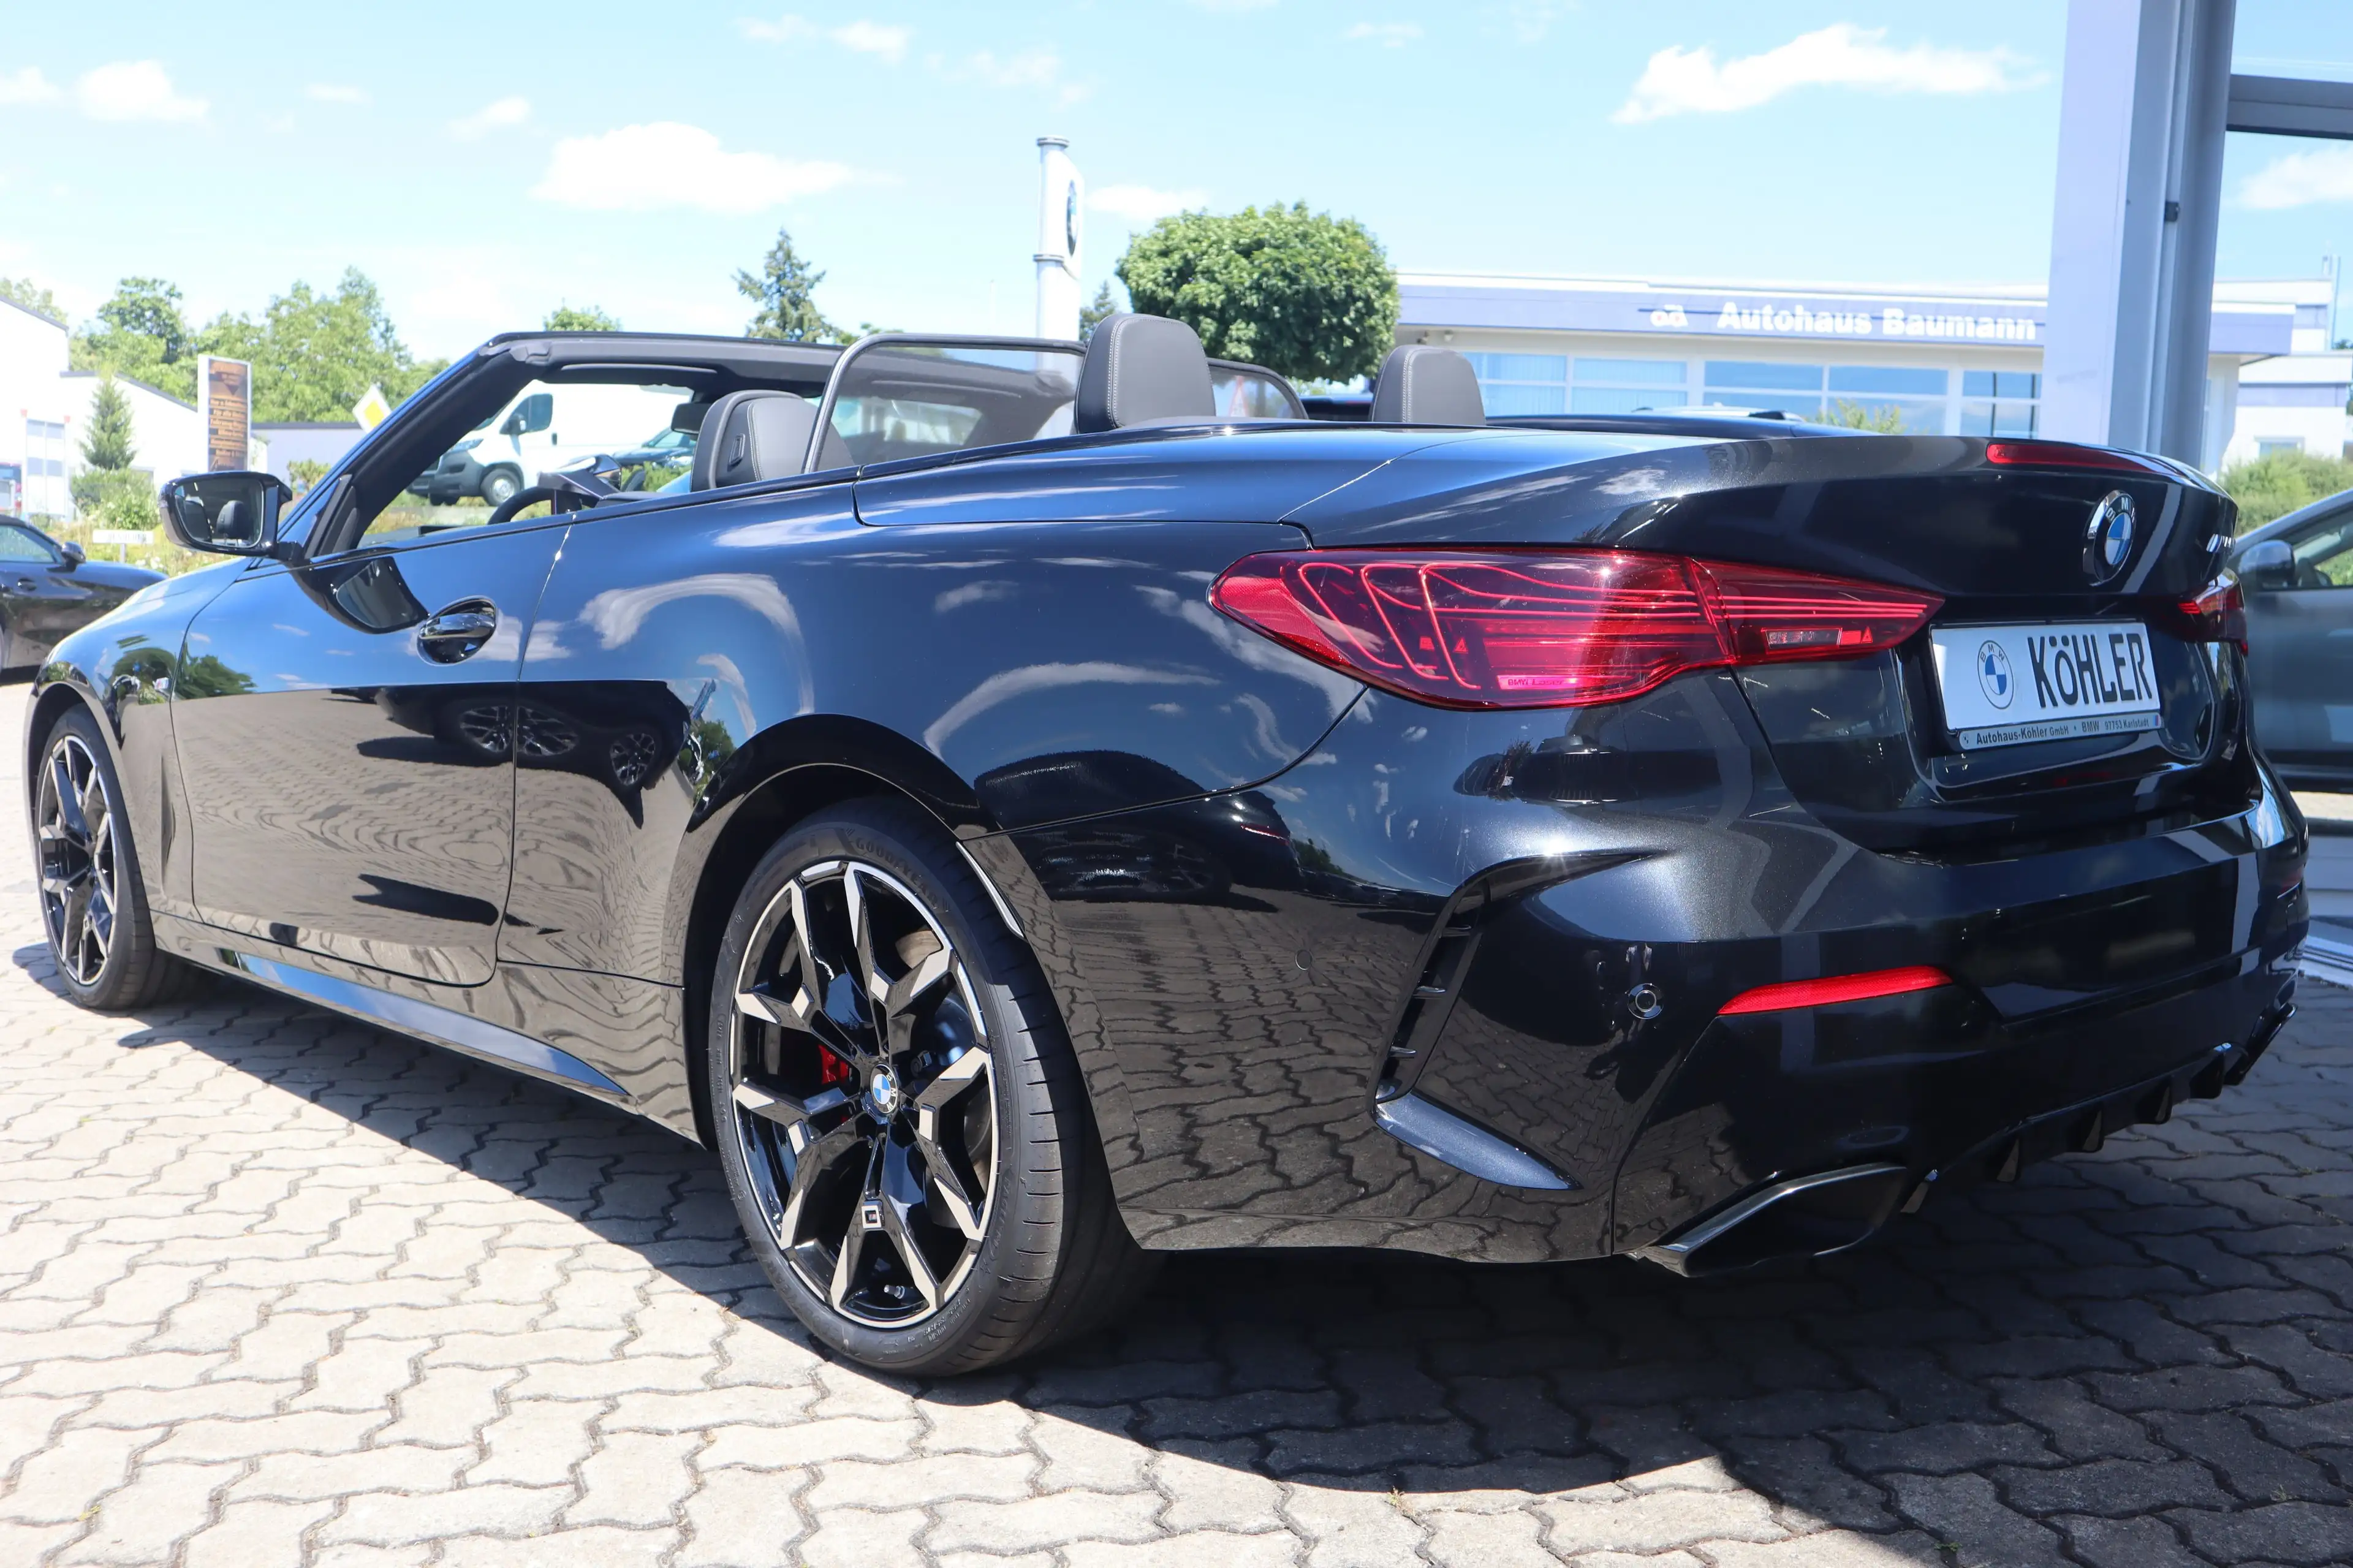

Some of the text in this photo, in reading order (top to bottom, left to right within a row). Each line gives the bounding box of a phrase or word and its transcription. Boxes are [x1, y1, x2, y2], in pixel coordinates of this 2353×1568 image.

[1717, 301, 2036, 340] Autohaus Baumann
[1980, 643, 2005, 663] BMW
[2028, 634, 2152, 708] KÖHLER
[1977, 718, 2150, 744] Autohaus-Köhler GmbH BMW 97753 Karlstadt
[855, 836, 939, 909] GOODYEAR
[886, 1071, 896, 1112] BMW
